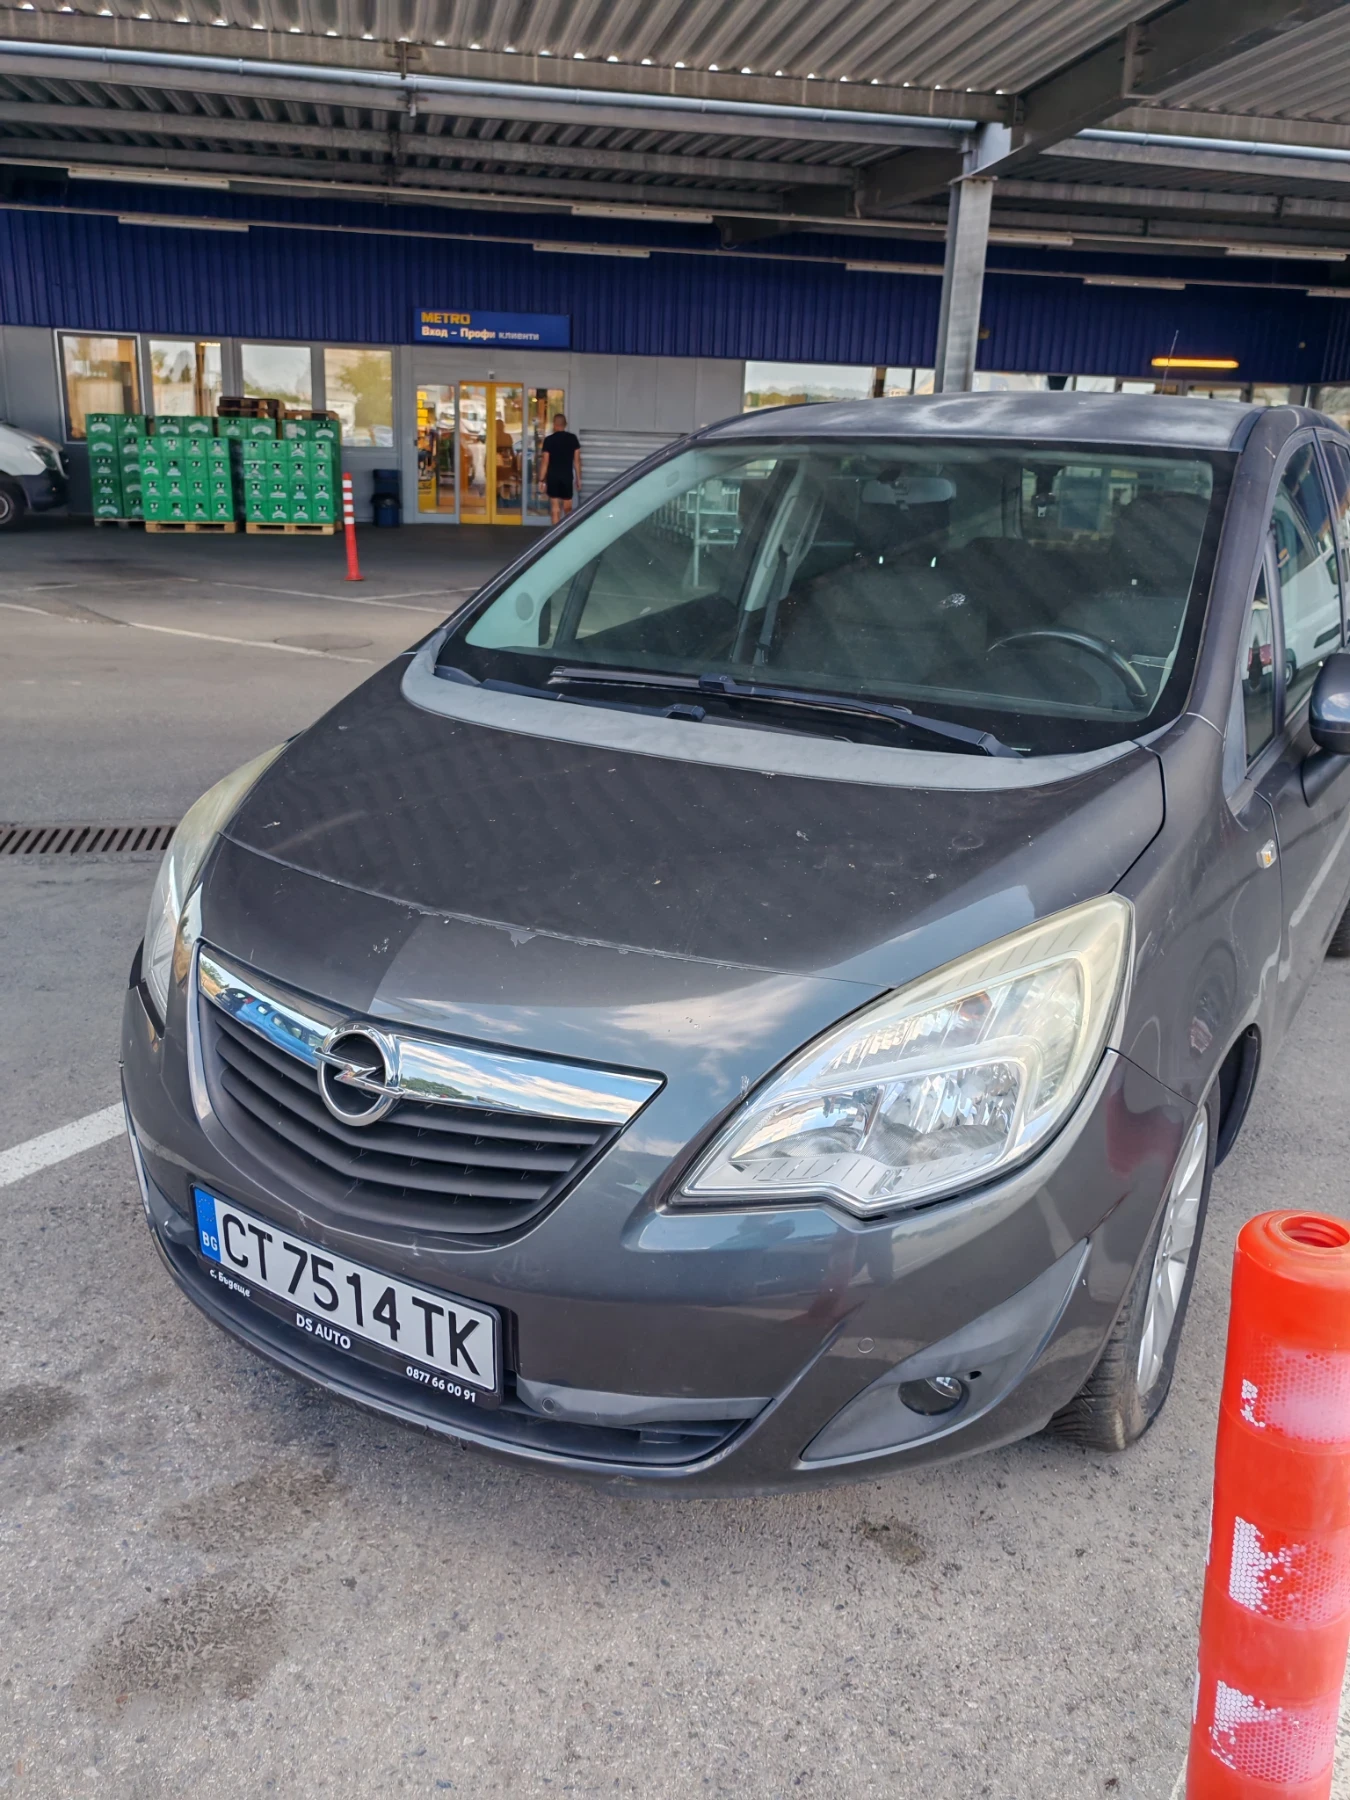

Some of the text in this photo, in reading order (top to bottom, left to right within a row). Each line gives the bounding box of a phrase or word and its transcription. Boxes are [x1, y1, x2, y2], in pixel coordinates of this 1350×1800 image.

[421, 312, 471, 325] METRO
[421, 326, 448, 338] Вход
[460, 328, 495, 340] Профи
[498, 332, 540, 341] клиенти
[202, 1231, 218, 1252] BG
[296, 1313, 351, 1350] DS AUTO
[406, 1366, 477, 1403] 0877 66 00 91
